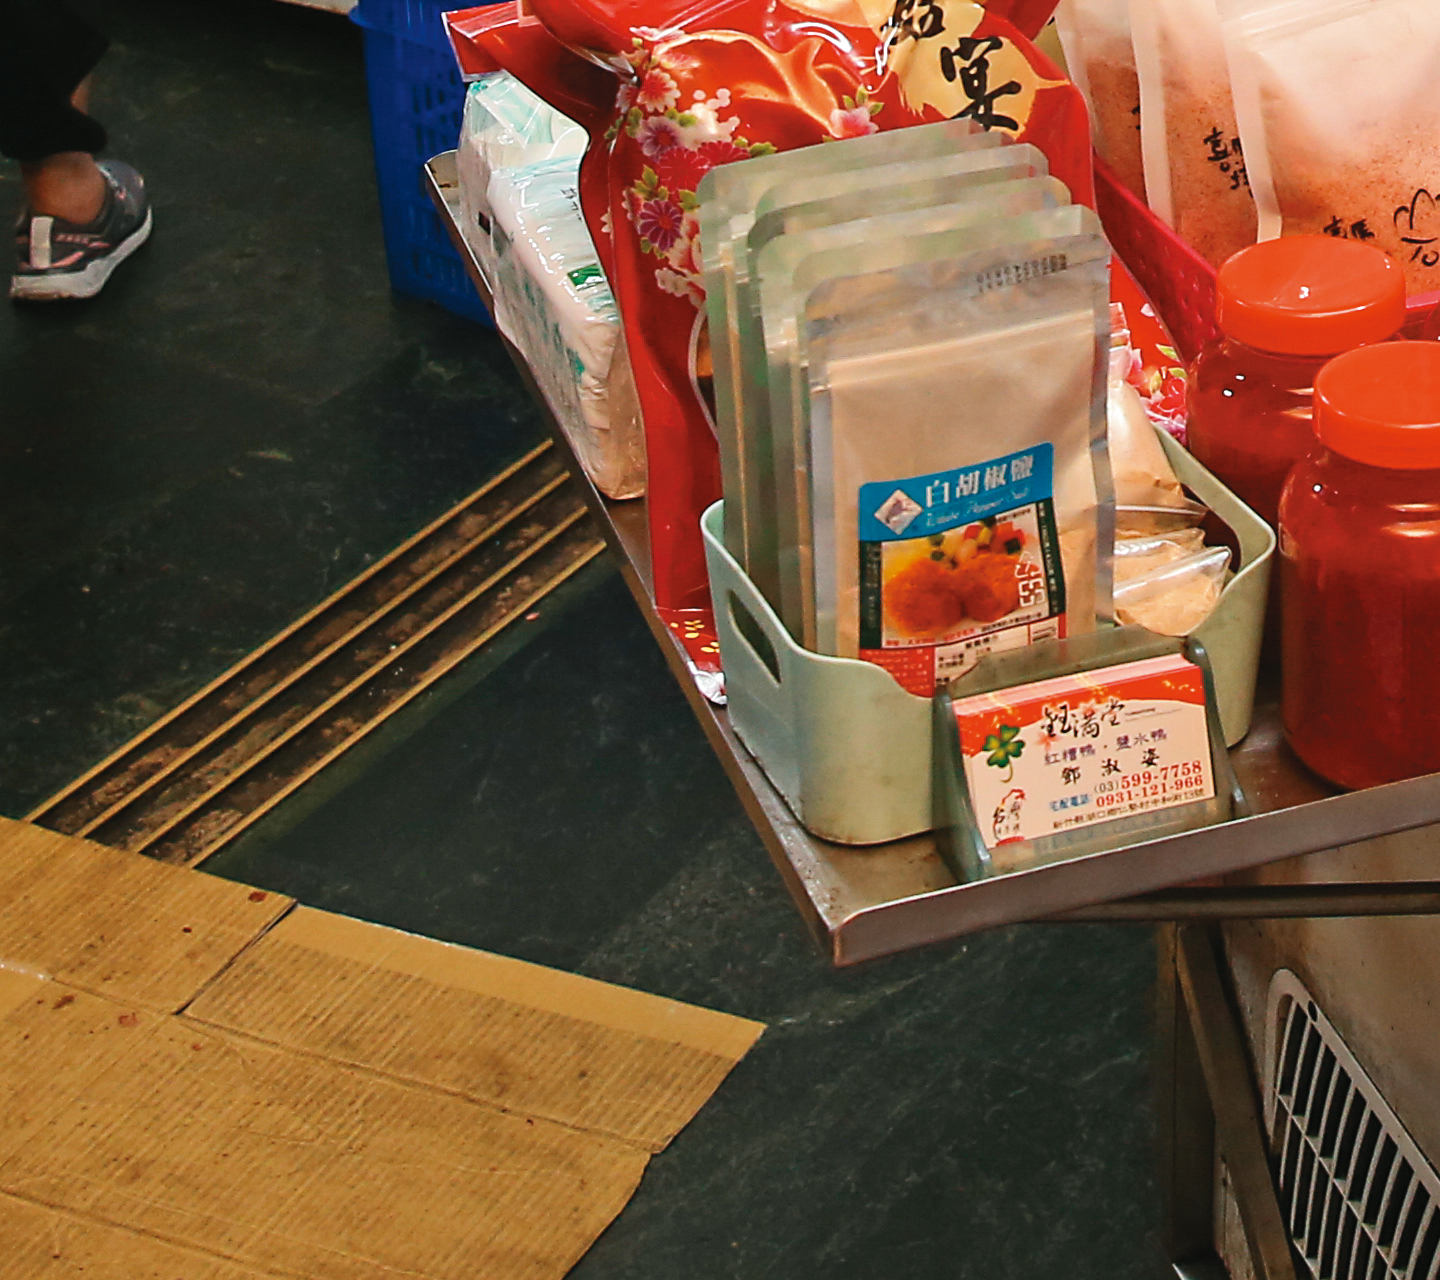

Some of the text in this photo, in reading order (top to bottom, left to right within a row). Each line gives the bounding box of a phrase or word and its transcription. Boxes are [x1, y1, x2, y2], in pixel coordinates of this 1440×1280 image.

[926, 454, 1034, 508] 白胡椒鹽
[1096, 775, 1203, 808] 0931-121-966
